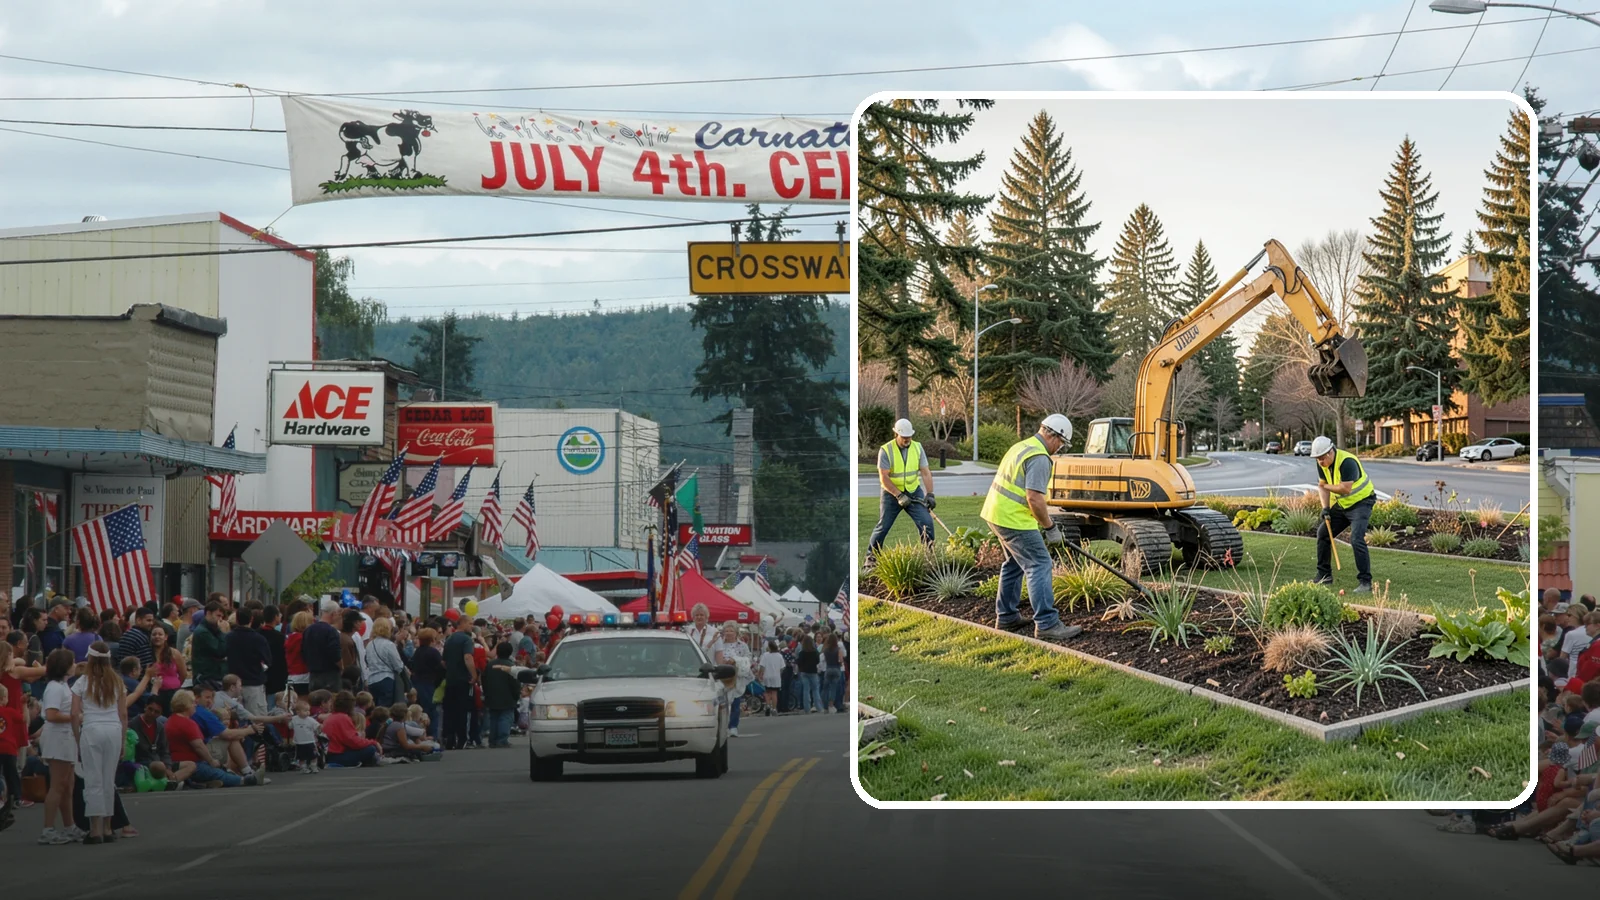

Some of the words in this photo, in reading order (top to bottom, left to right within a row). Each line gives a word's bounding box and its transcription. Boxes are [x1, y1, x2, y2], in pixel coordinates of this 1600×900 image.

[481, 141, 605, 192] JULY
[632, 149, 747, 198] 4th.
[697, 254, 850, 280] CROSSWA
[283, 380, 373, 420] ACE
[406, 410, 452, 422] CEDAR
[284, 421, 371, 436] Hardware
[416, 428, 478, 447] Coca-Cola
[95, 486, 124, 495] Vincent
[126, 486, 136, 495] de
[138, 486, 155, 495] Paul
[688, 526, 741, 535] CRNATION
[699, 535, 730, 543] GLASS
